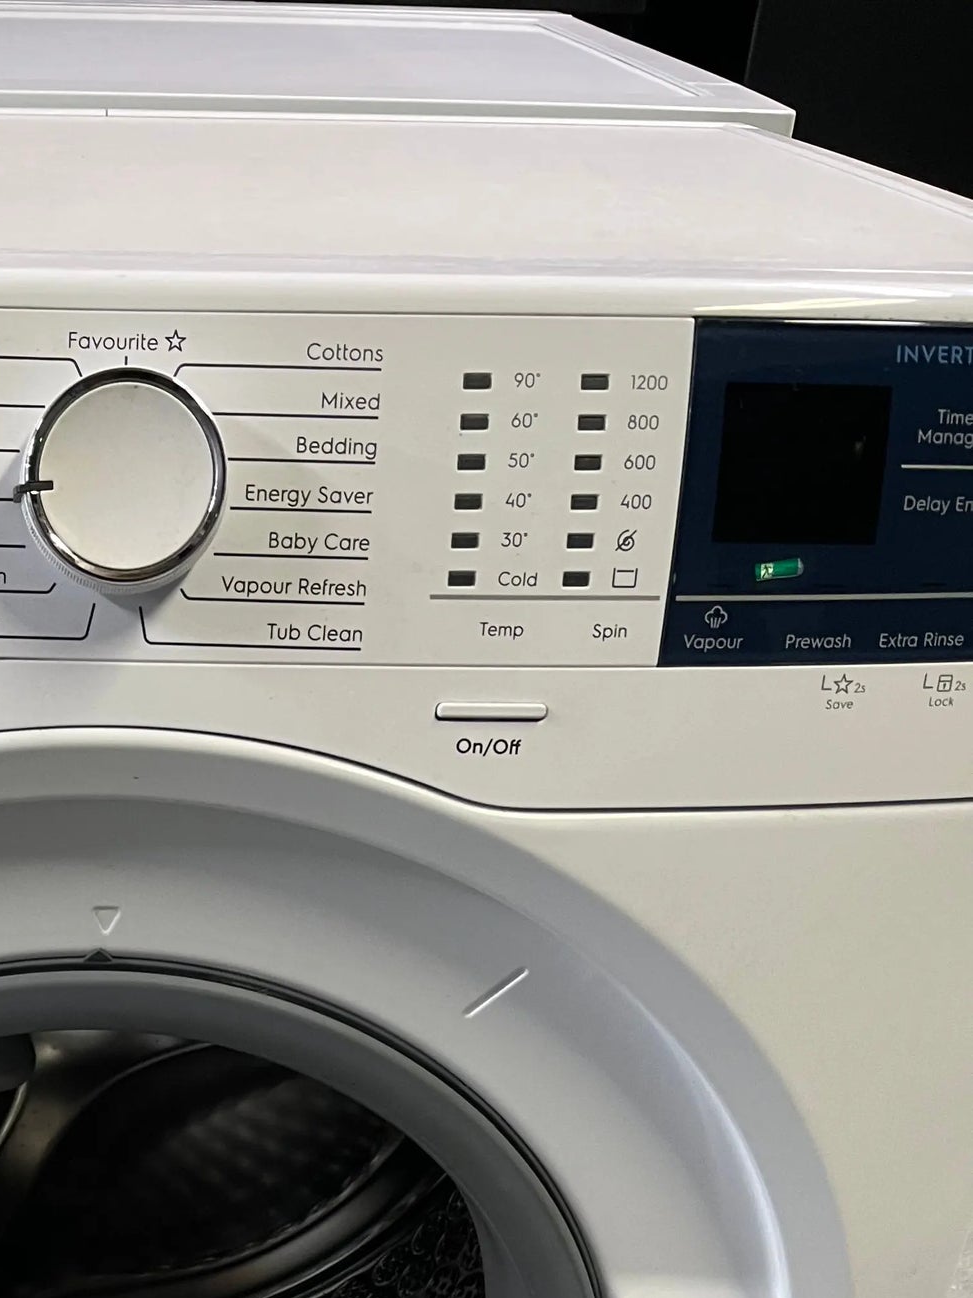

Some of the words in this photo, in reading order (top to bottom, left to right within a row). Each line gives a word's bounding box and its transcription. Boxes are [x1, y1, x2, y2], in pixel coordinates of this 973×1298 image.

[69, 332, 158, 351] Favourite
[307, 343, 383, 361] Cottons
[897, 345, 973, 364] INVERT
[632, 375, 668, 390] 1200
[322, 393, 380, 410] Mixed
[628, 415, 659, 430] 800
[938, 409, 973, 425] Time
[297, 437, 377, 457] Bedding
[918, 429, 973, 448] Manag
[624, 455, 655, 470] 600
[246, 484, 311, 507] Energy
[318, 486, 373, 504] Saver
[621, 495, 651, 509] 400
[904, 496, 950, 515] Delay
[269, 532, 318, 553] Baby
[325, 533, 369, 551] Care
[222, 576, 292, 597] Vapour
[299, 578, 366, 596] Refresh
[498, 572, 537, 586] Cold
[267, 623, 300, 640] Tub
[308, 625, 362, 642] Clean
[480, 622, 523, 640] Temp
[593, 624, 627, 641] Spin
[684, 635, 743, 652] Vapour
[786, 634, 851, 648] Prewash
[879, 633, 918, 648] Extra
[924, 632, 964, 646] Rinse
[826, 699, 853, 709] Save
[929, 697, 953, 706] Lock
[456, 738, 521, 756] On/Off
